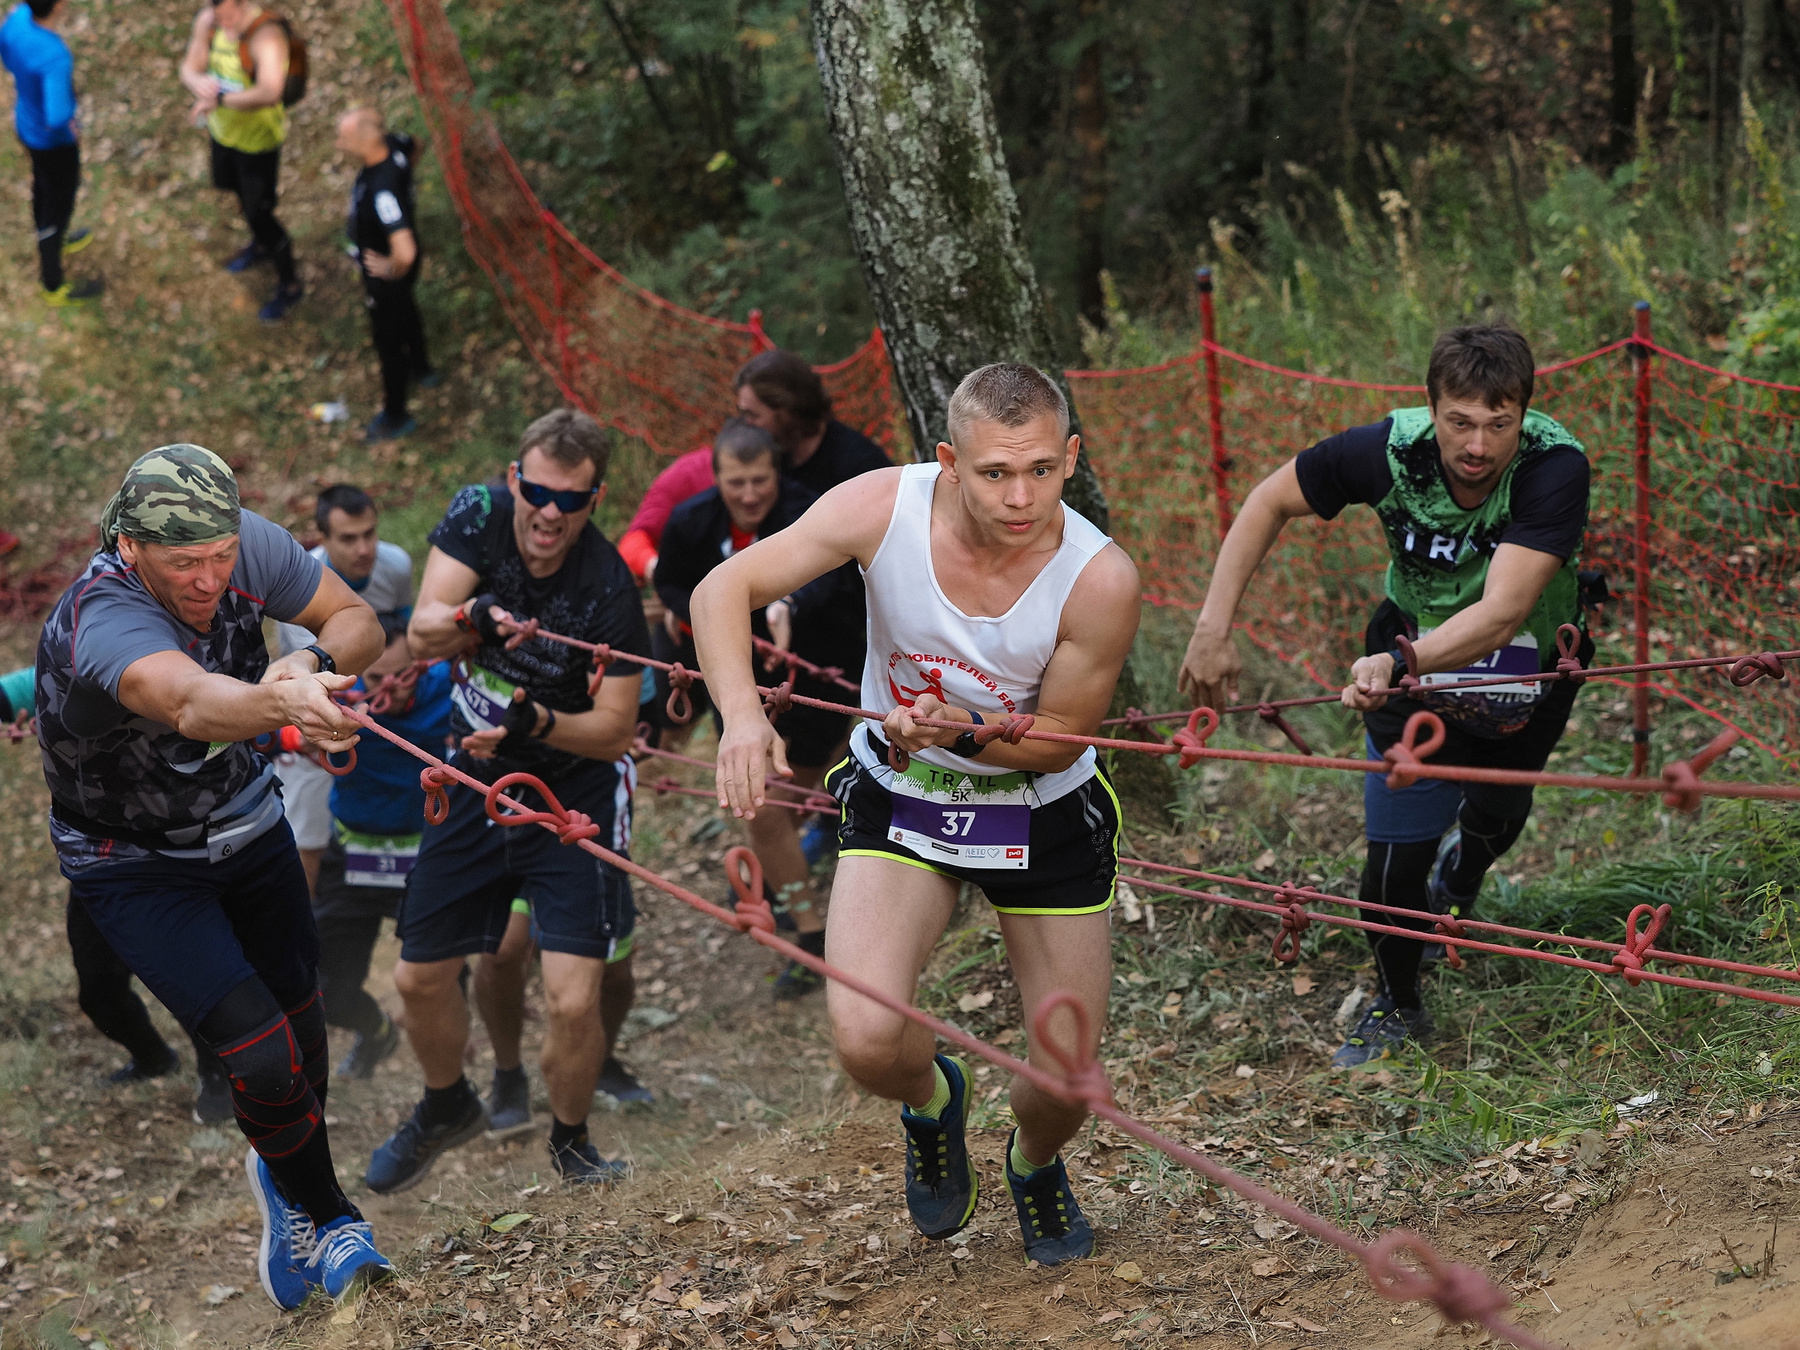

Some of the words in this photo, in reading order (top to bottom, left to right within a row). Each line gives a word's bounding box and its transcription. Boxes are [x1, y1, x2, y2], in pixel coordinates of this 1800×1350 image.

[464, 687, 491, 717] 475
[929, 769, 997, 789] TRAIL
[951, 791, 970, 802] 5K
[940, 811, 976, 837] 37
